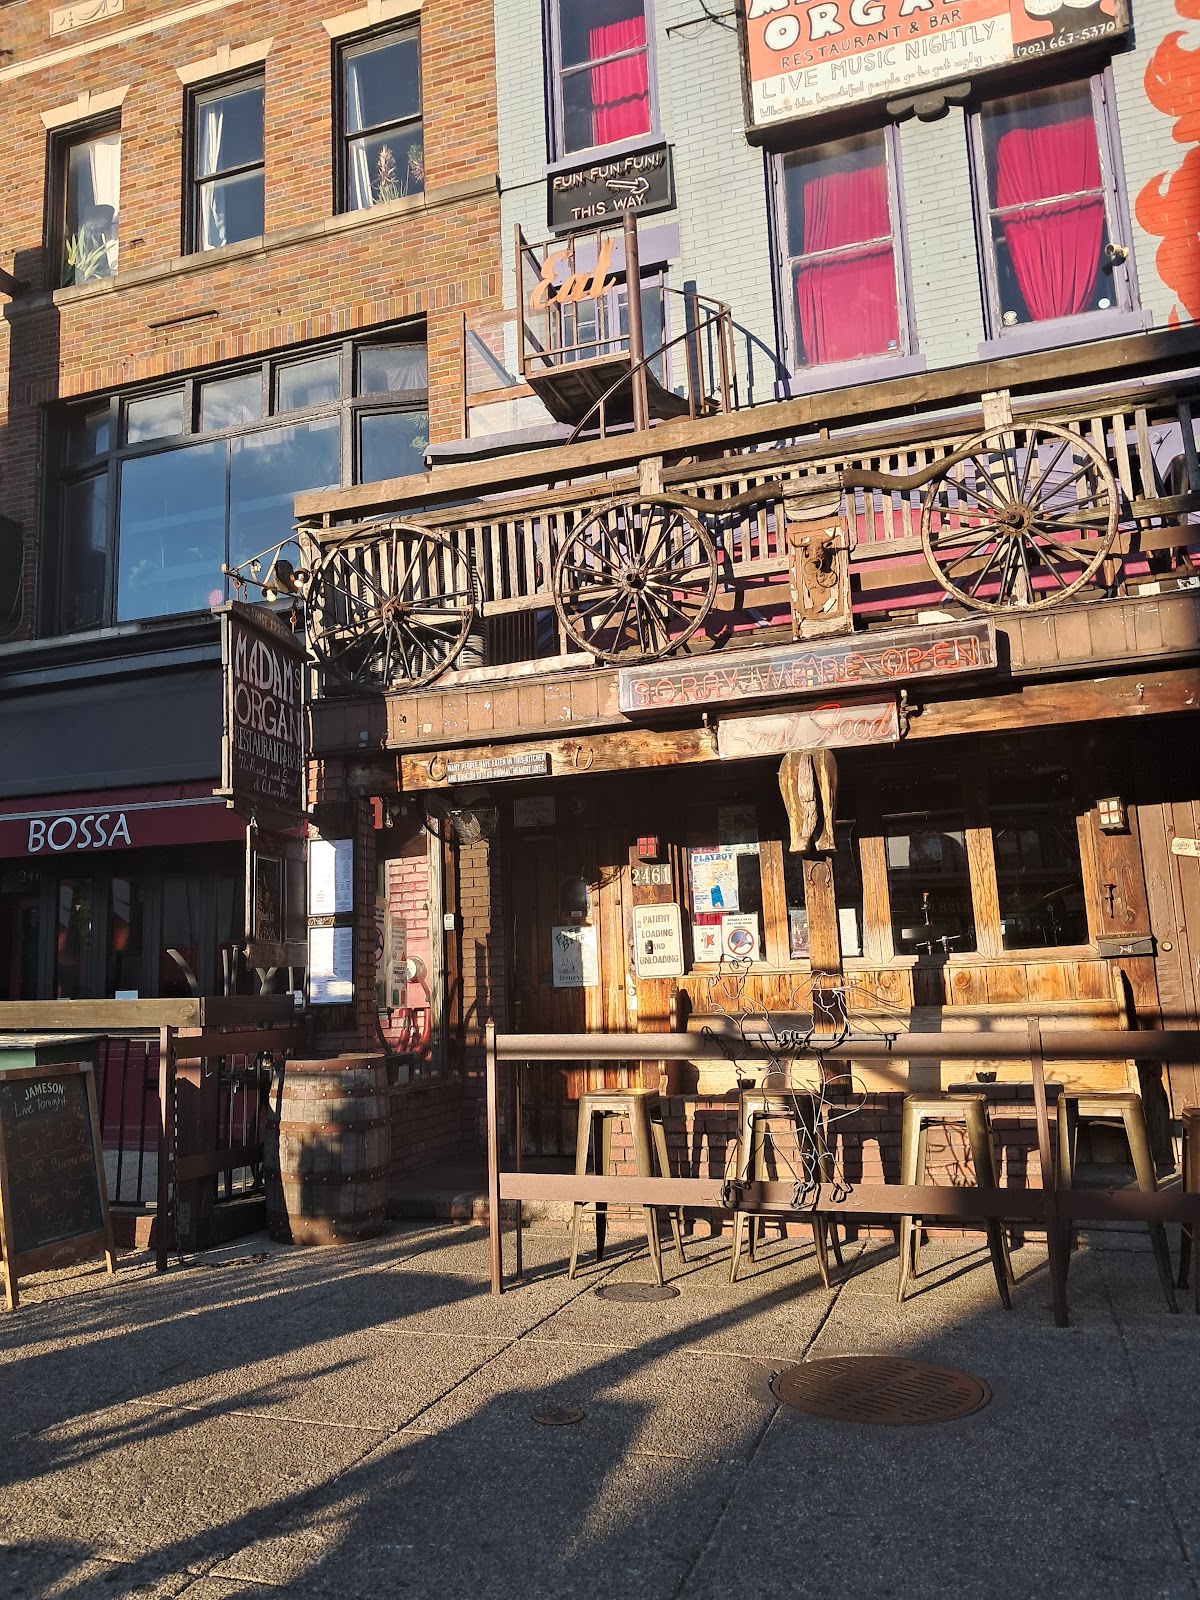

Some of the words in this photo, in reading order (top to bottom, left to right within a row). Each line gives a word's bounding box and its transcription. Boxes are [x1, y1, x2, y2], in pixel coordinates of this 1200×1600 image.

[782, 25, 902, 69] RESTAURANT
[909, 21, 920, 34] &
[929, 9, 962, 28] BAR
[1016, 40, 1046, 57] (202)
[1049, 21, 1115, 50] 667-5370
[762, 68, 818, 99] LIVE
[831, 47, 896, 80] MUSIC
[905, 21, 995, 61] NIGHTLY
[795, 95, 813, 111] the
[815, 80, 864, 104] beautiful
[868, 73, 900, 95] people
[903, 71, 915, 85] go
[917, 65, 930, 77] to
[932, 58, 951, 78] get
[553, 171, 584, 189] FUN
[590, 162, 620, 180] FUN
[624, 153, 660, 171] FUN!
[571, 201, 606, 220] THIS
[613, 193, 645, 211] WAY
[530, 237, 617, 310] Eat
[633, 670, 740, 706] SORRY
[881, 638, 978, 678] OPEN
[234, 682, 301, 747] ORGAN
[725, 713, 801, 755] Soul
[804, 701, 897, 747] Food
[27, 813, 132, 853] BOSSA
[632, 866, 671, 885] 2461
[693, 852, 734, 864] PLAYBOY
[641, 928, 674, 939] LOADING
[643, 914, 671, 925] PATIENT
[639, 954, 680, 965] UNLOADING
[14, 1101, 35, 1118] Live
[24, 1082, 65, 1101] JAMESON
[60, 1121, 73, 1139] 10
